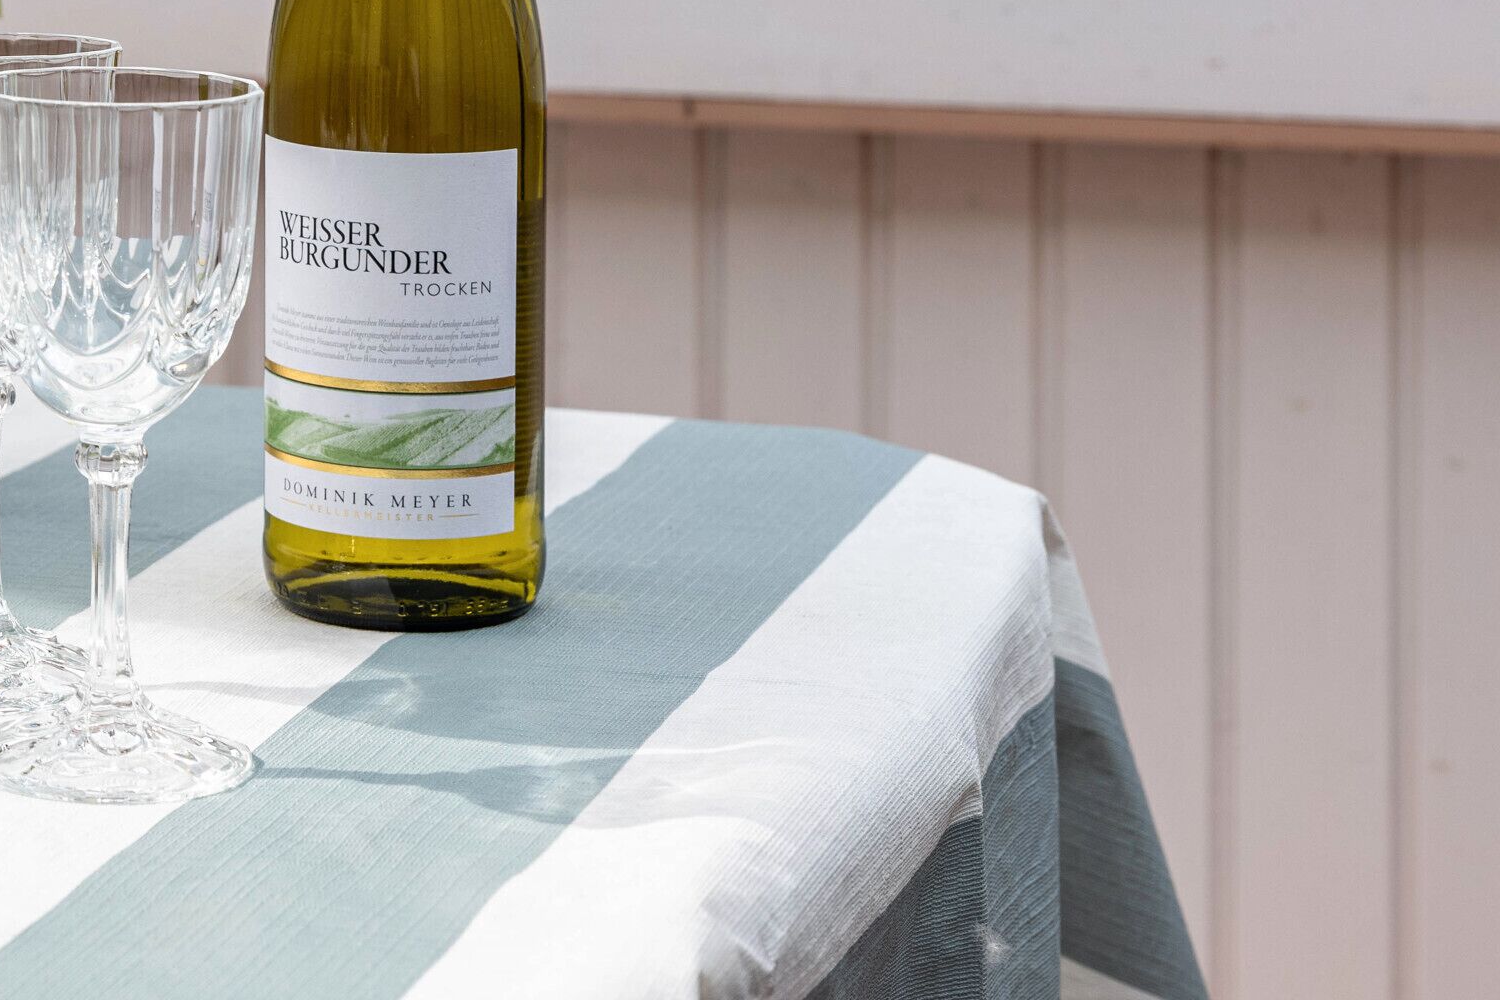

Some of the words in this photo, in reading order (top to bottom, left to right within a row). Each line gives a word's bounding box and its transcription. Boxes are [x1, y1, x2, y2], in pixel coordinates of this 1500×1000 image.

[279, 210, 384, 247] WEISSER
[279, 236, 452, 275] BURGUNDER
[400, 280, 492, 297] TROCKEN
[283, 477, 375, 507] DOMINIK
[391, 493, 472, 508] MEYER
[308, 504, 434, 521] KELLERMEISTER
